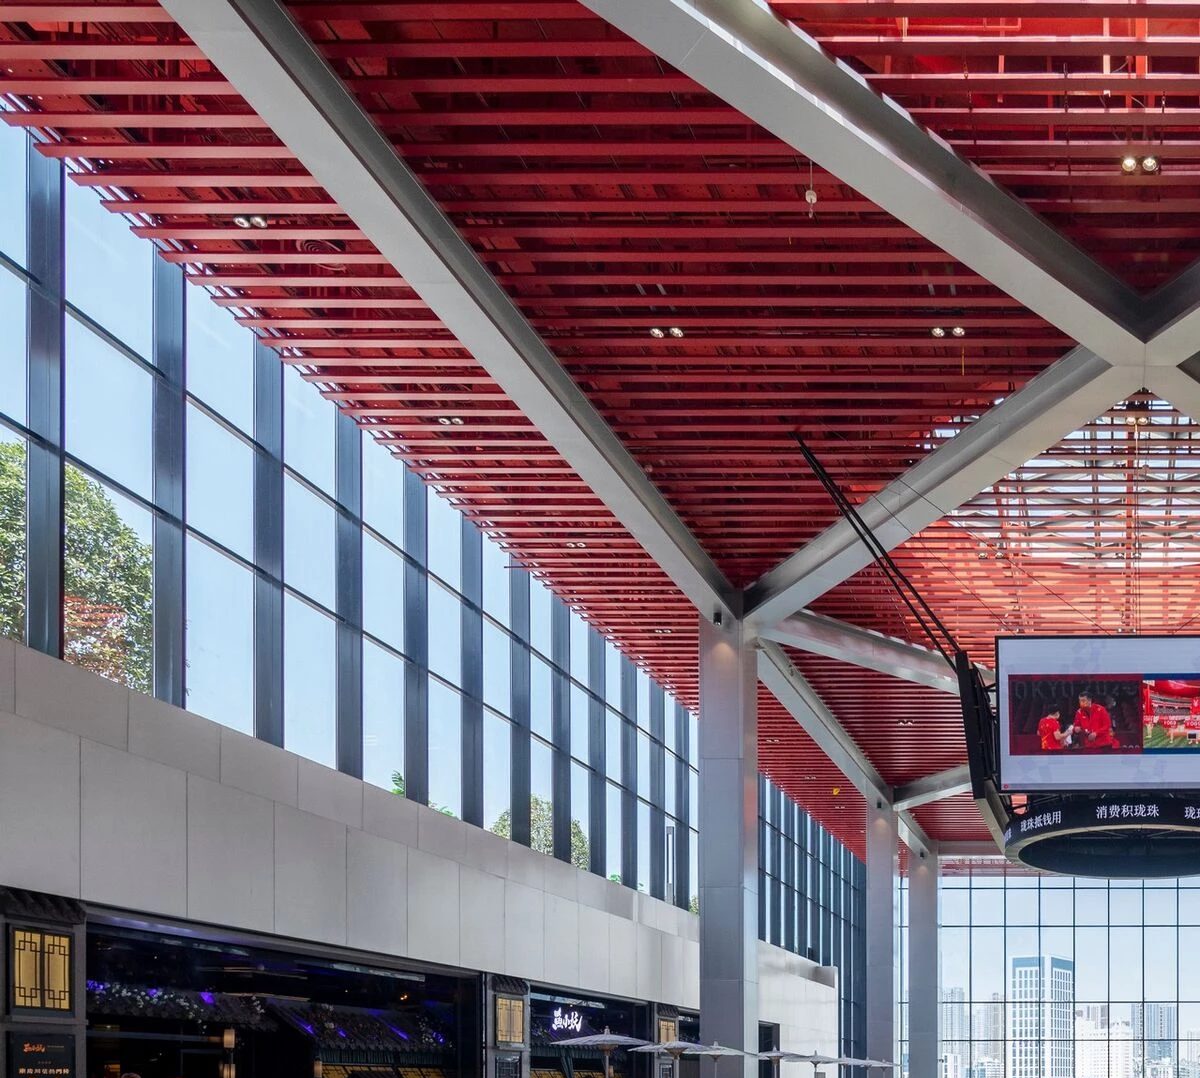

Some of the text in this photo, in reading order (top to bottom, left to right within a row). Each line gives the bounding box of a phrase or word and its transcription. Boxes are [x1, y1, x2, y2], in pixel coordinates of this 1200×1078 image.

[1096, 804, 1160, 819] 消费积珑珠
[1020, 810, 1062, 833] 珑珠抵钱用
